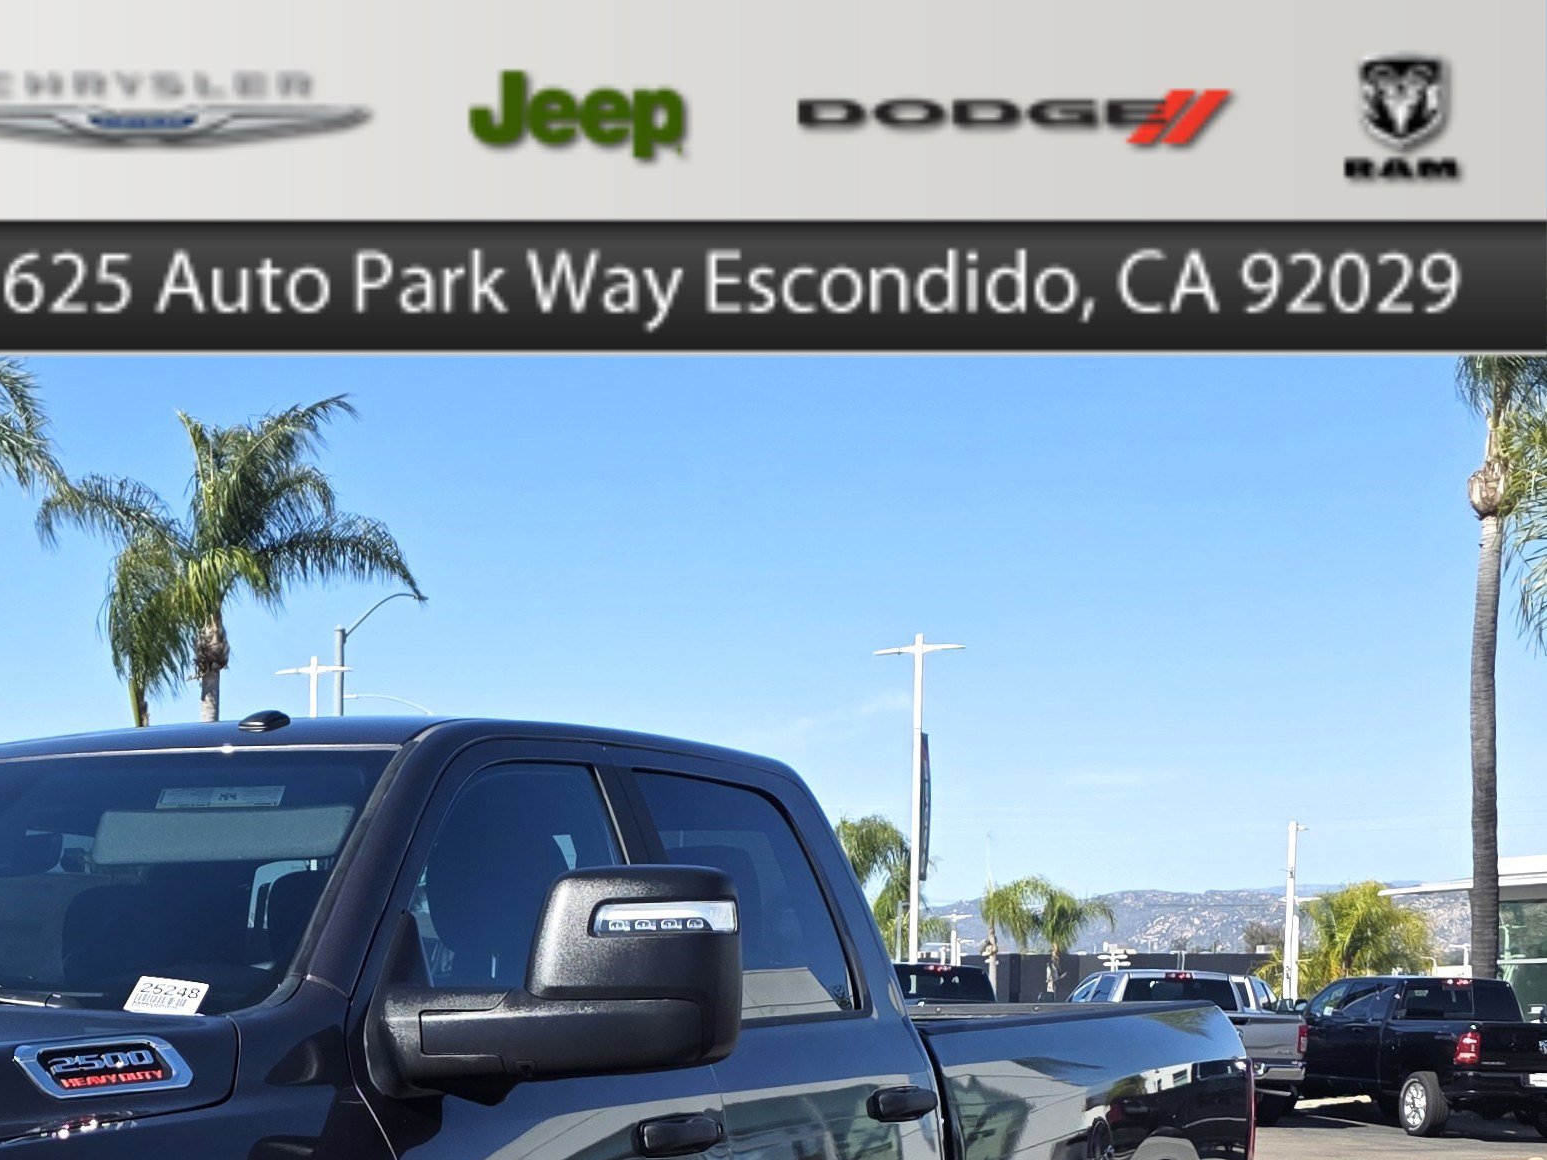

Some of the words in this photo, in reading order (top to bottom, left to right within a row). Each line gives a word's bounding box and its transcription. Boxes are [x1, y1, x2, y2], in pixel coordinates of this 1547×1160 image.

[140, 982, 201, 999] 25248
[48, 1049, 154, 1076] 2500
[60, 1073, 117, 1088] HEAVY
[117, 1069, 163, 1083] DUTY
